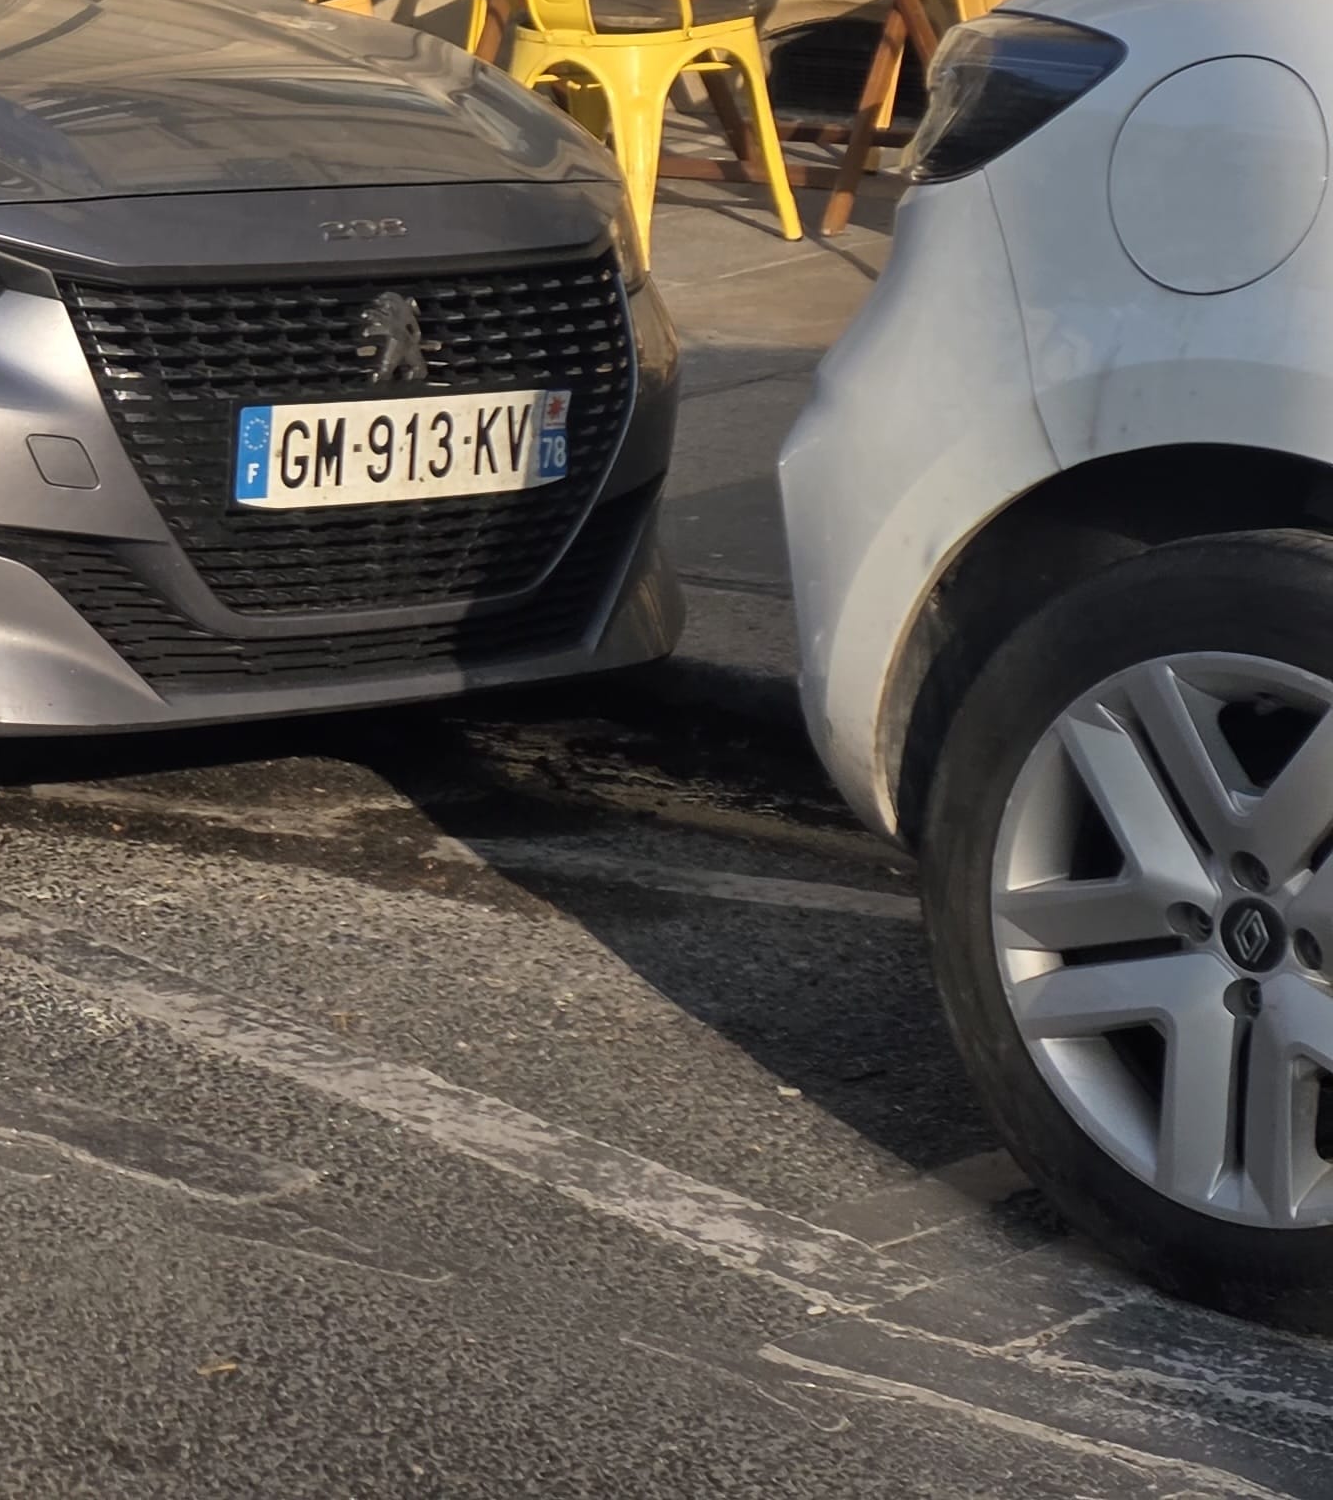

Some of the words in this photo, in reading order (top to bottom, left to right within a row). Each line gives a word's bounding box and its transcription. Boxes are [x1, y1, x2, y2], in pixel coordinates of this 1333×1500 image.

[280, 404, 532, 489] GM-913-KV
[542, 434, 567, 469] 78
[247, 463, 260, 484] F
